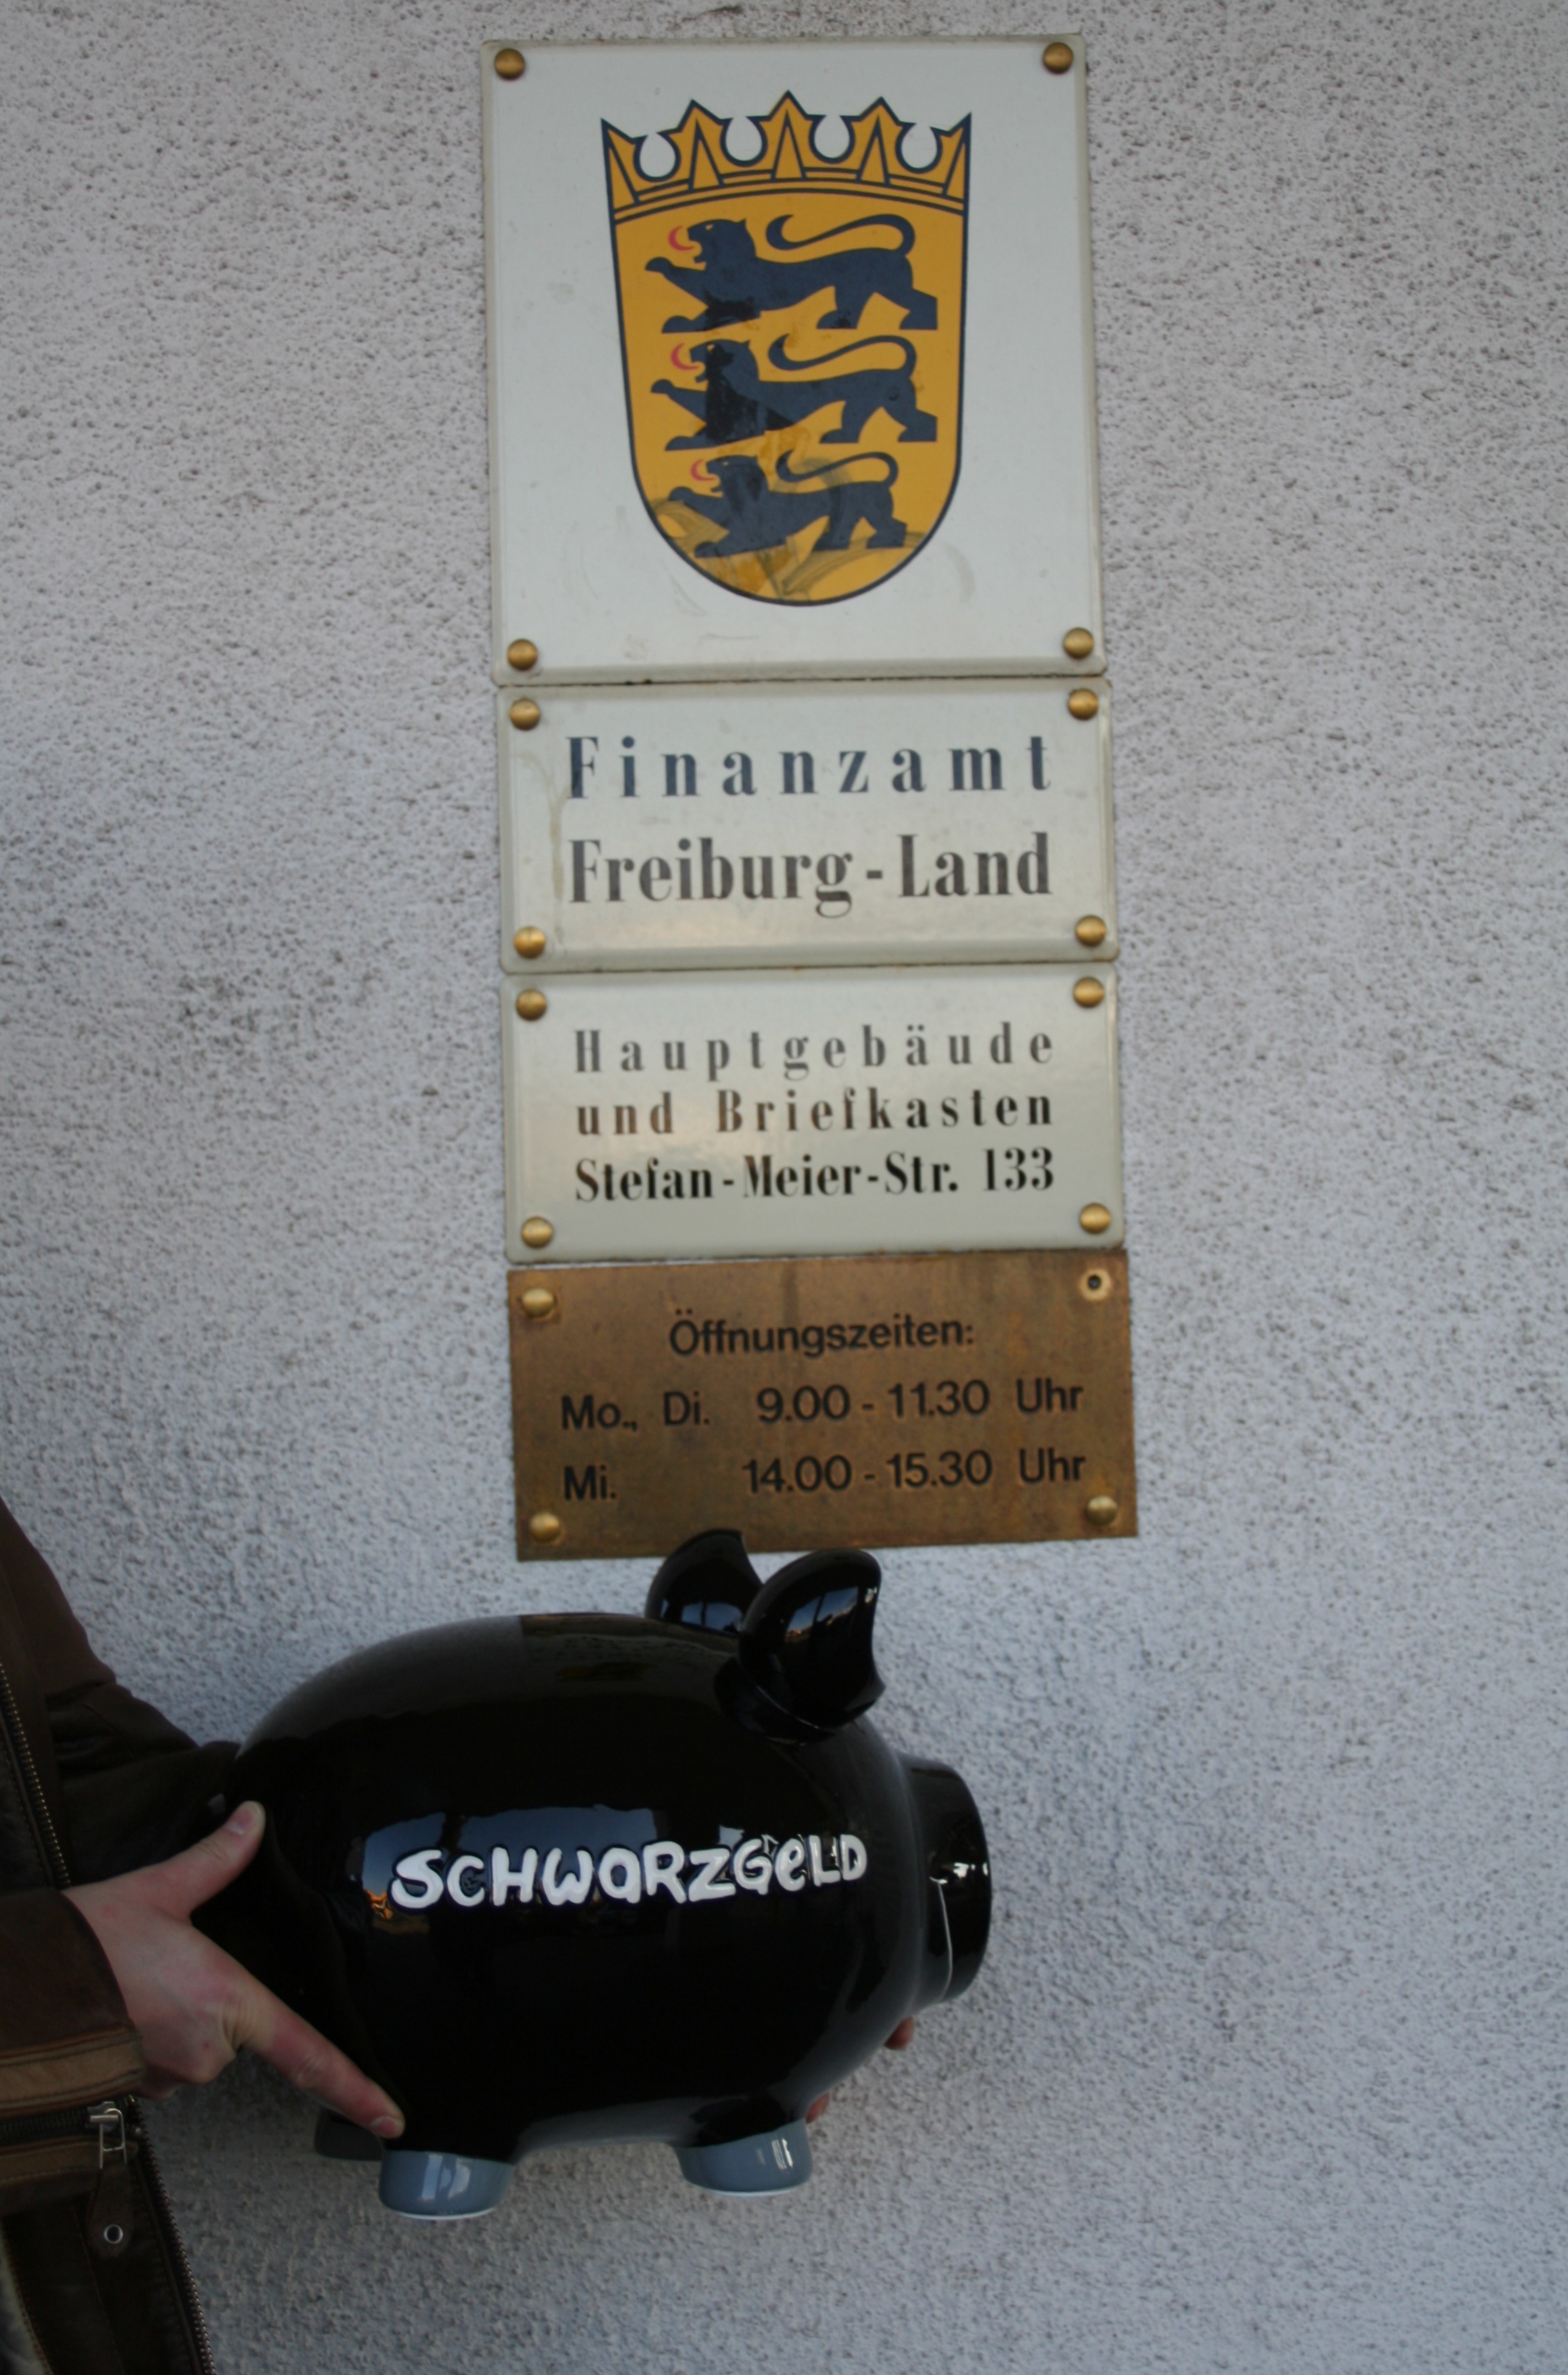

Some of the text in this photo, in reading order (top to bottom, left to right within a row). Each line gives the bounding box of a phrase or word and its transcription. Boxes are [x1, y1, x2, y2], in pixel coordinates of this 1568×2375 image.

[567, 736, 1052, 800] Finanzamt
[574, 1021, 1053, 1081] Hauptgebäude
[576, 1087, 1053, 1135] und Briefkasten
[575, 1147, 1054, 1202] Stefan-Meier-Str. 133
[669, 1309, 974, 1358] Öffnungszeiten:
[560, 1394, 638, 1431] Mo.,
[663, 1391, 710, 1426] Di.
[1016, 1377, 1084, 1414] Uhr
[563, 1465, 618, 1502] Mi.
[1019, 1448, 1086, 1485] Uhr
